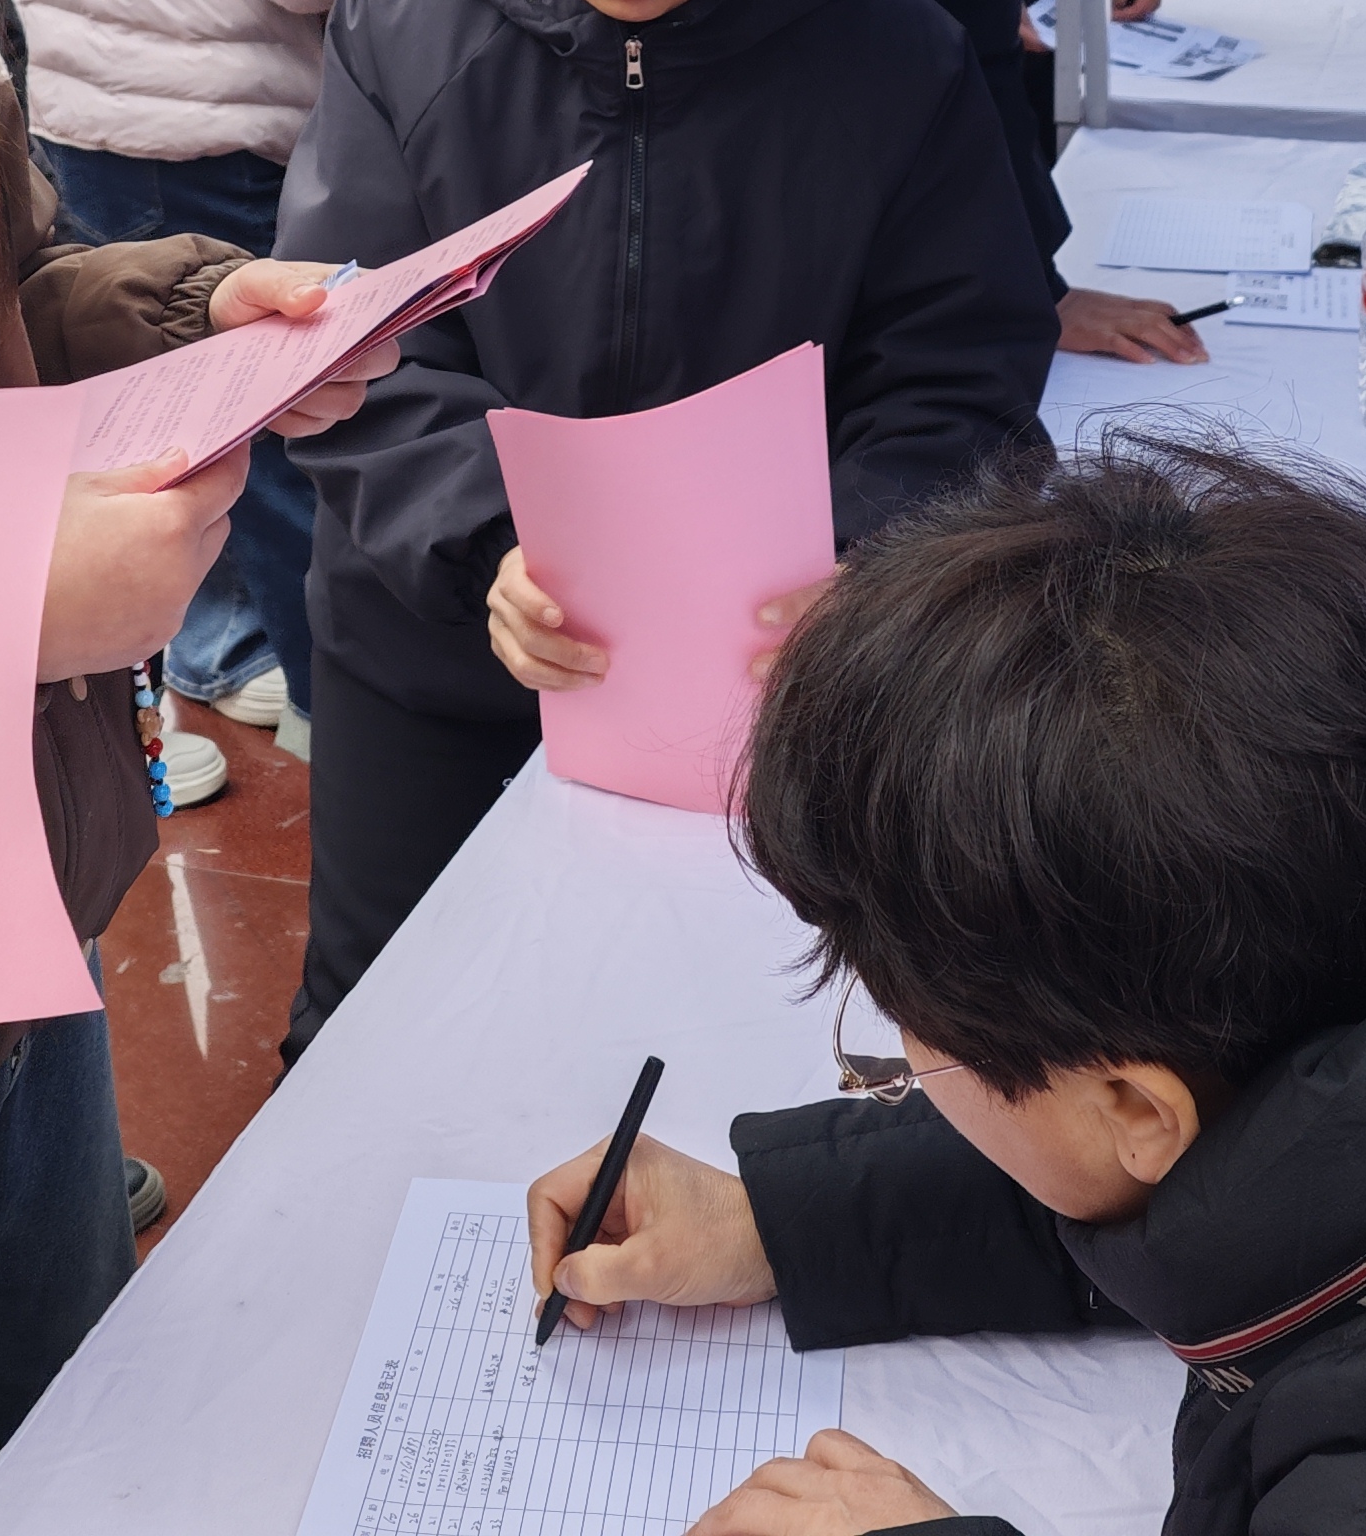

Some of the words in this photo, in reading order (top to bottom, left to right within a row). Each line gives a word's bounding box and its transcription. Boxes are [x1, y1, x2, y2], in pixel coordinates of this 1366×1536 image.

[355, 1357, 401, 1461] 招聘人员信息登记表
[406, 1512, 420, 1524] 26
[447, 1518, 460, 1530] 21
